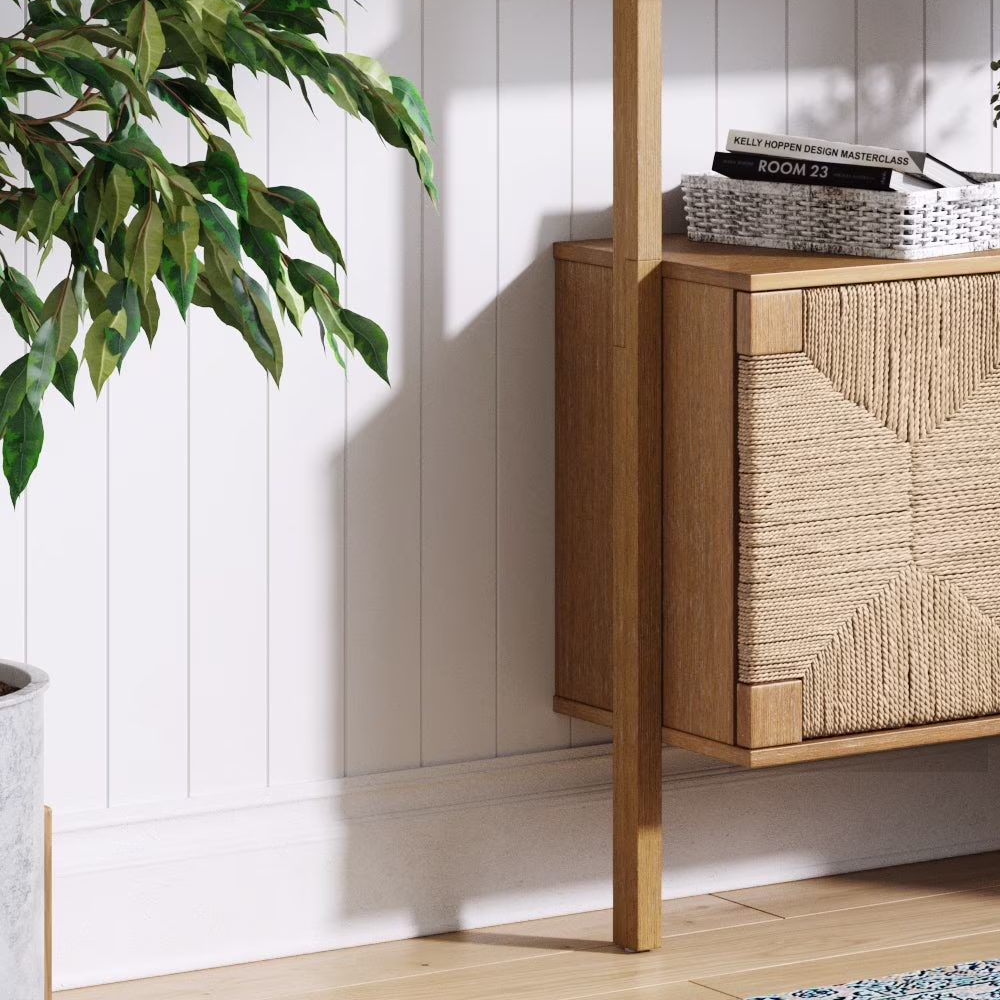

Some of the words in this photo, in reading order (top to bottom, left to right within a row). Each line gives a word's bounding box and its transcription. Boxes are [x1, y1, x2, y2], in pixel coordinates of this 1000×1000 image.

[733, 136, 763, 147] KELLY
[764, 140, 802, 152] HOPPEN
[804, 145, 839, 157] DESIGN
[840, 150, 909, 166] MASTERCLASS
[758, 160, 806, 176] ROOM
[810, 165, 828, 178] 23
